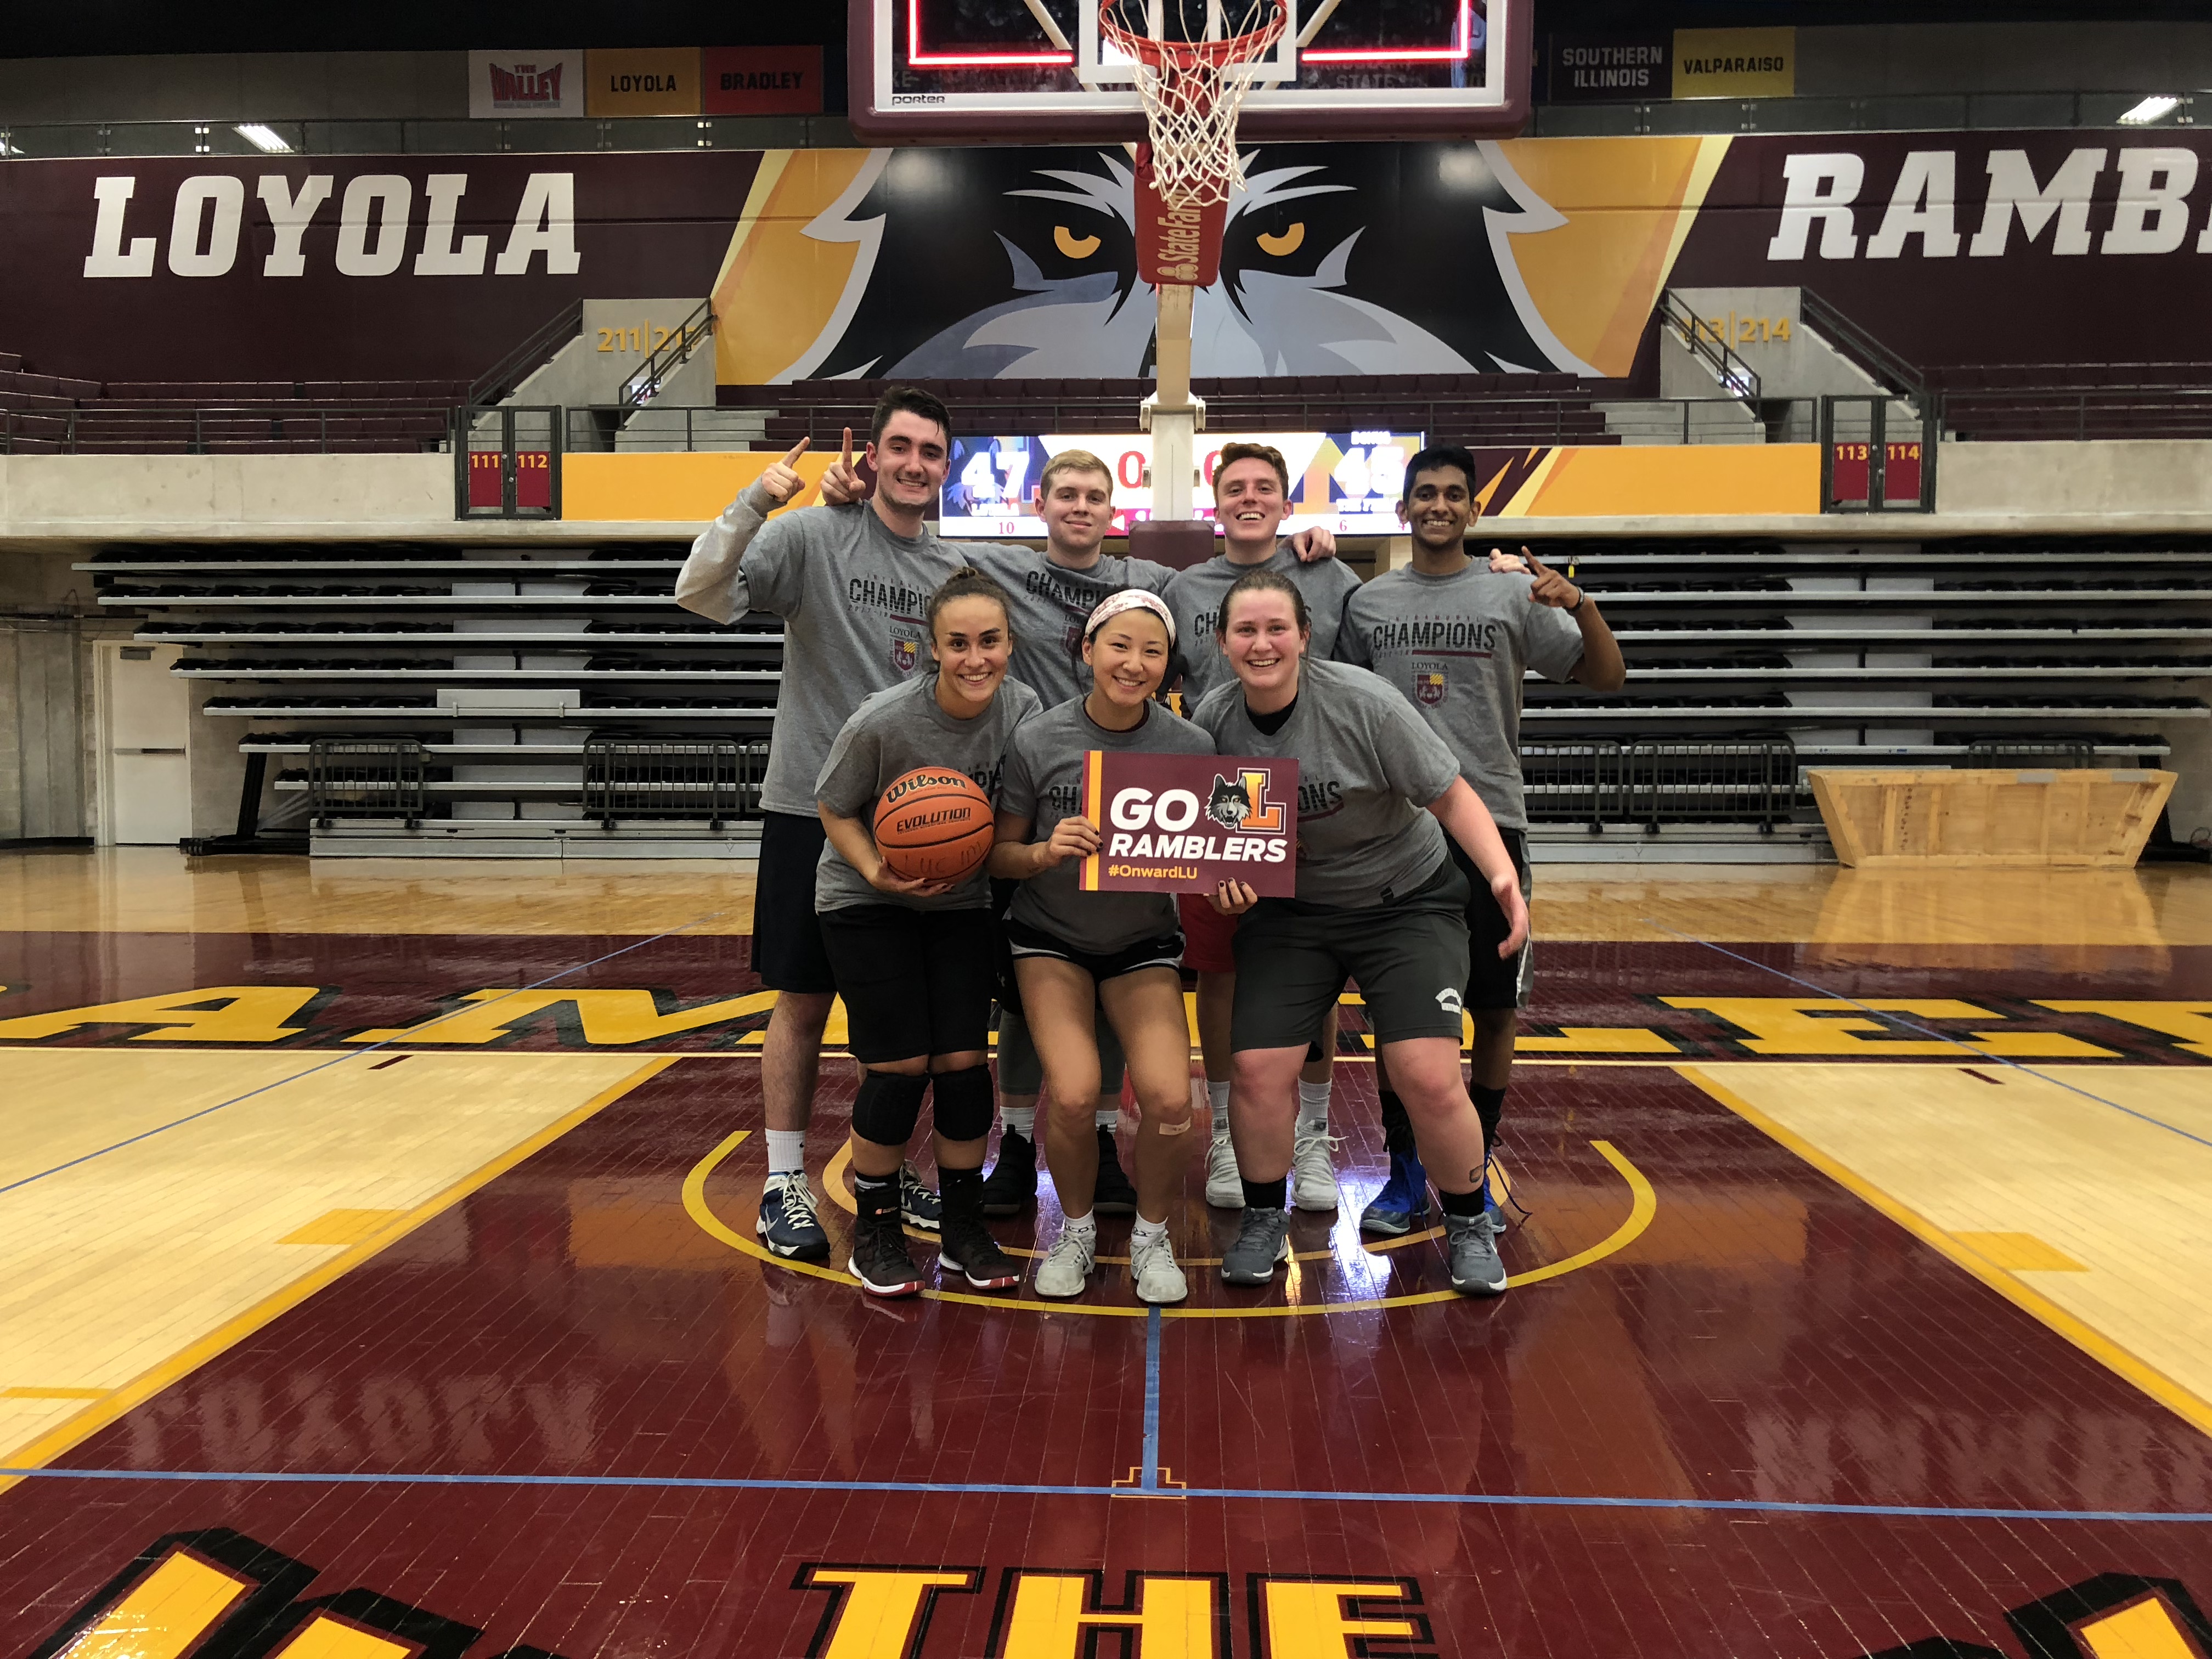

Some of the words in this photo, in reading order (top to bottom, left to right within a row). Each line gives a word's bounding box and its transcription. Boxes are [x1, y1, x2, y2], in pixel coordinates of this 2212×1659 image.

[1562, 46, 1663, 66] SOUTHERN
[514, 64, 537, 73] THE
[1684, 57, 1784, 75] VALPARAISO
[489, 63, 563, 101] VALLEY
[610, 75, 676, 92] LOYOLA
[720, 72, 803, 90] BRADLEY
[1575, 70, 1649, 87] ILLINOIS
[1767, 147, 2212, 261] RAMB
[83, 172, 581, 278] LOYOLA
[597, 326, 640, 352] 211
[1739, 317, 1791, 343] 214
[472, 455, 499, 468] 111
[518, 455, 548, 468] 112
[1837, 445, 1867, 460] 113
[1888, 445, 1919, 460] 114
[961, 452, 1030, 498] 47
[1118, 451, 1146, 488] 0
[998, 522, 1014, 534] 10
[1339, 520, 1347, 531] 6
[889, 626, 921, 640] LOYOLA
[1373, 622, 1497, 651] CHAMPIONS
[1411, 662, 1448, 670] LOYOLA
[886, 774, 967, 803] Wilson
[1110, 787, 1199, 832] GO
[896, 807, 971, 832] EVOLUTION
[1109, 834, 1288, 862] RAMBLERS
[1108, 864, 1198, 879] #OnwardLU
